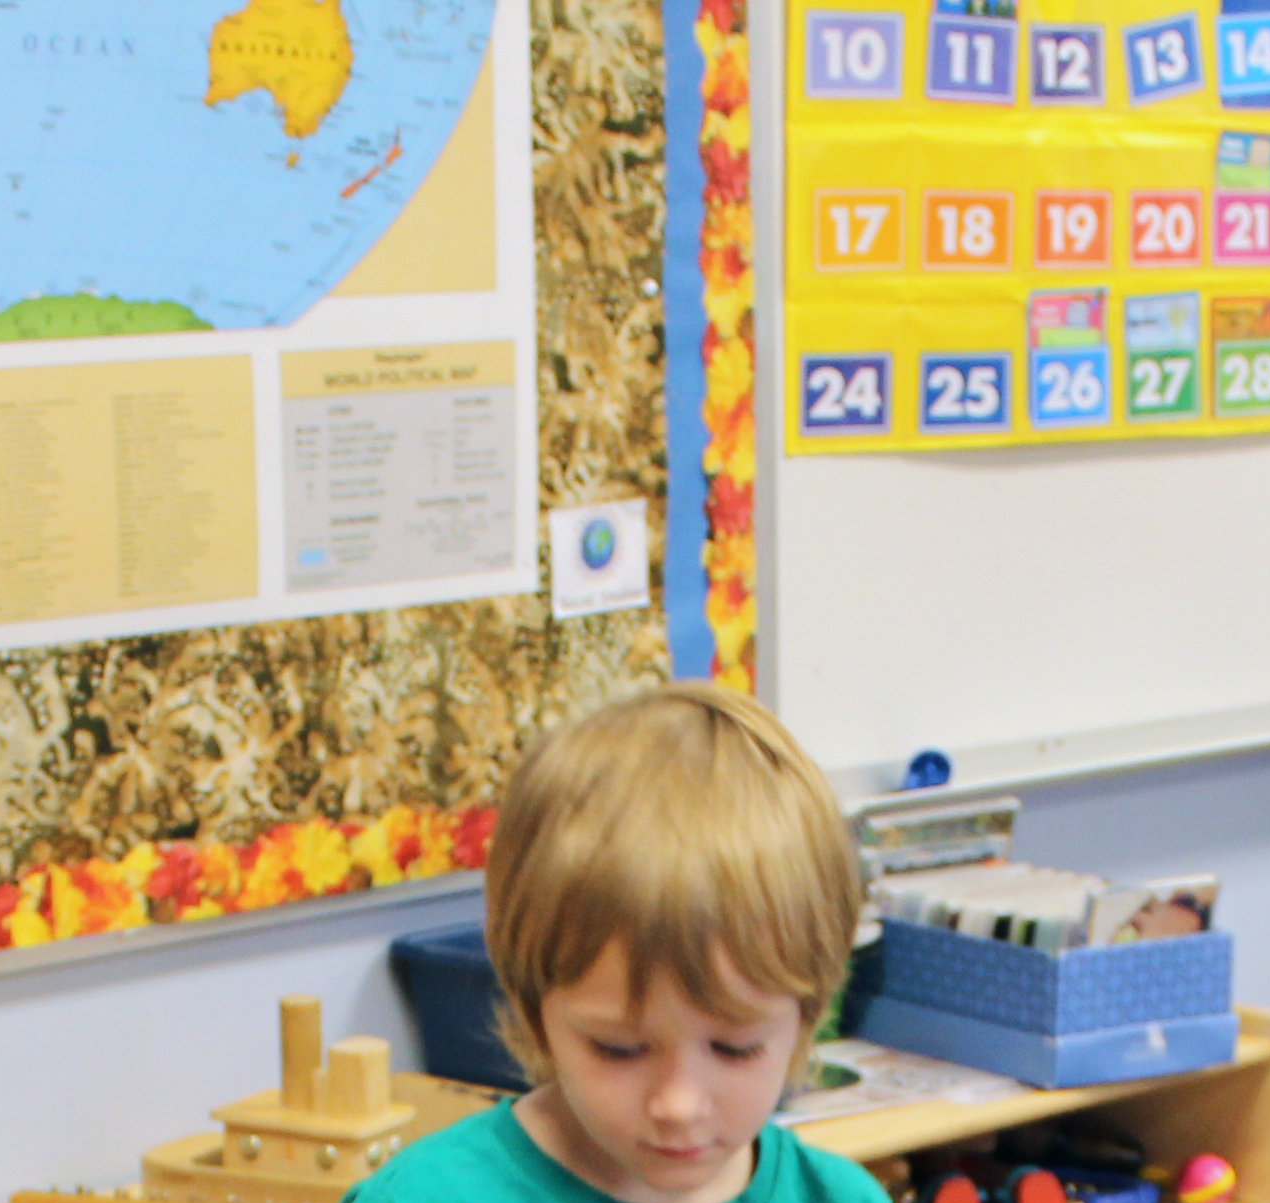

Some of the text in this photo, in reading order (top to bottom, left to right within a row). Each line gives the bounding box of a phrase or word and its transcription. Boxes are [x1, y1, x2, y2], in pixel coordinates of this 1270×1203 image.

[22, 33, 134, 55] OCEAN
[821, 27, 887, 82] 10
[946, 30, 994, 86] 11
[1037, 37, 1092, 90] 12
[1133, 28, 1190, 86] 13
[829, 203, 890, 256] 17
[937, 204, 997, 258] 18
[1046, 203, 1099, 254] 19
[1136, 202, 1196, 254] 20
[1223, 202, 1270, 251] 21
[808, 366, 883, 420] 24
[928, 366, 1001, 419] 25
[1039, 359, 1104, 412] 26
[1132, 356, 1193, 409] 27
